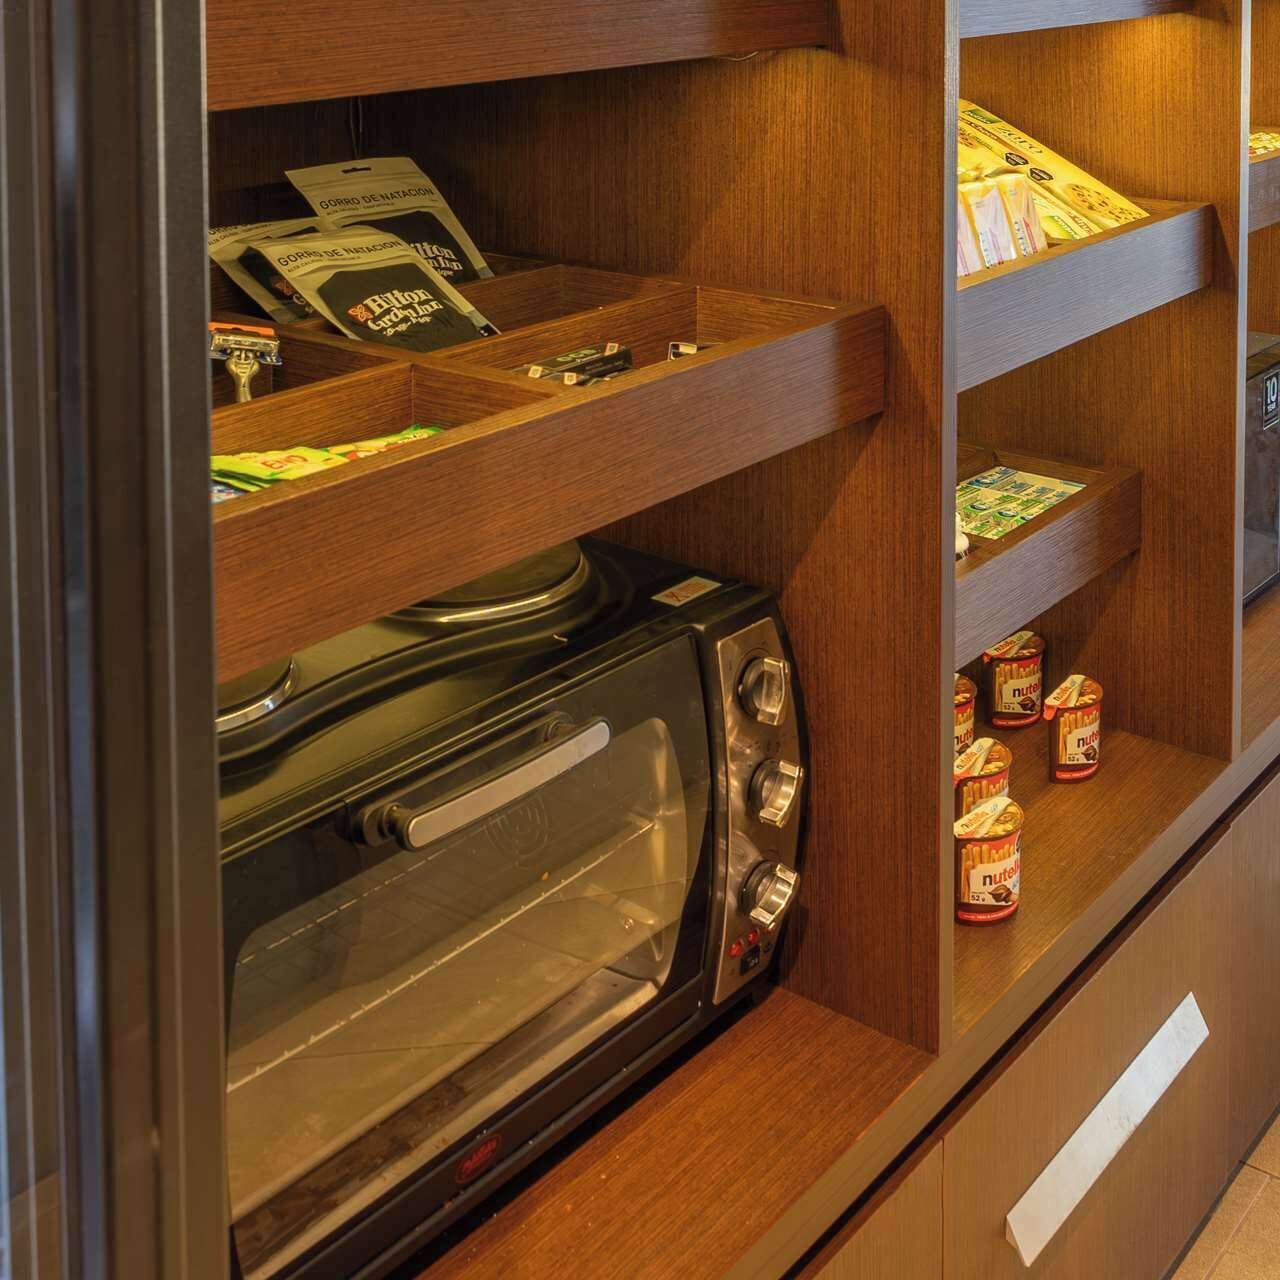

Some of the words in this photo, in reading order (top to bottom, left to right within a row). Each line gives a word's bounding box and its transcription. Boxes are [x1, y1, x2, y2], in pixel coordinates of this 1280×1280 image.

[319, 197, 360, 210] GORRO
[363, 194, 379, 205] DE
[277, 250, 321, 268] GORRO
[325, 249, 341, 258] DE
[363, 288, 434, 316] Hilton
[411, 299, 444, 322] Inn
[1266, 377, 1277, 404] 10
[260, 454, 309, 472] ENO
[971, 894, 982, 902] 52
